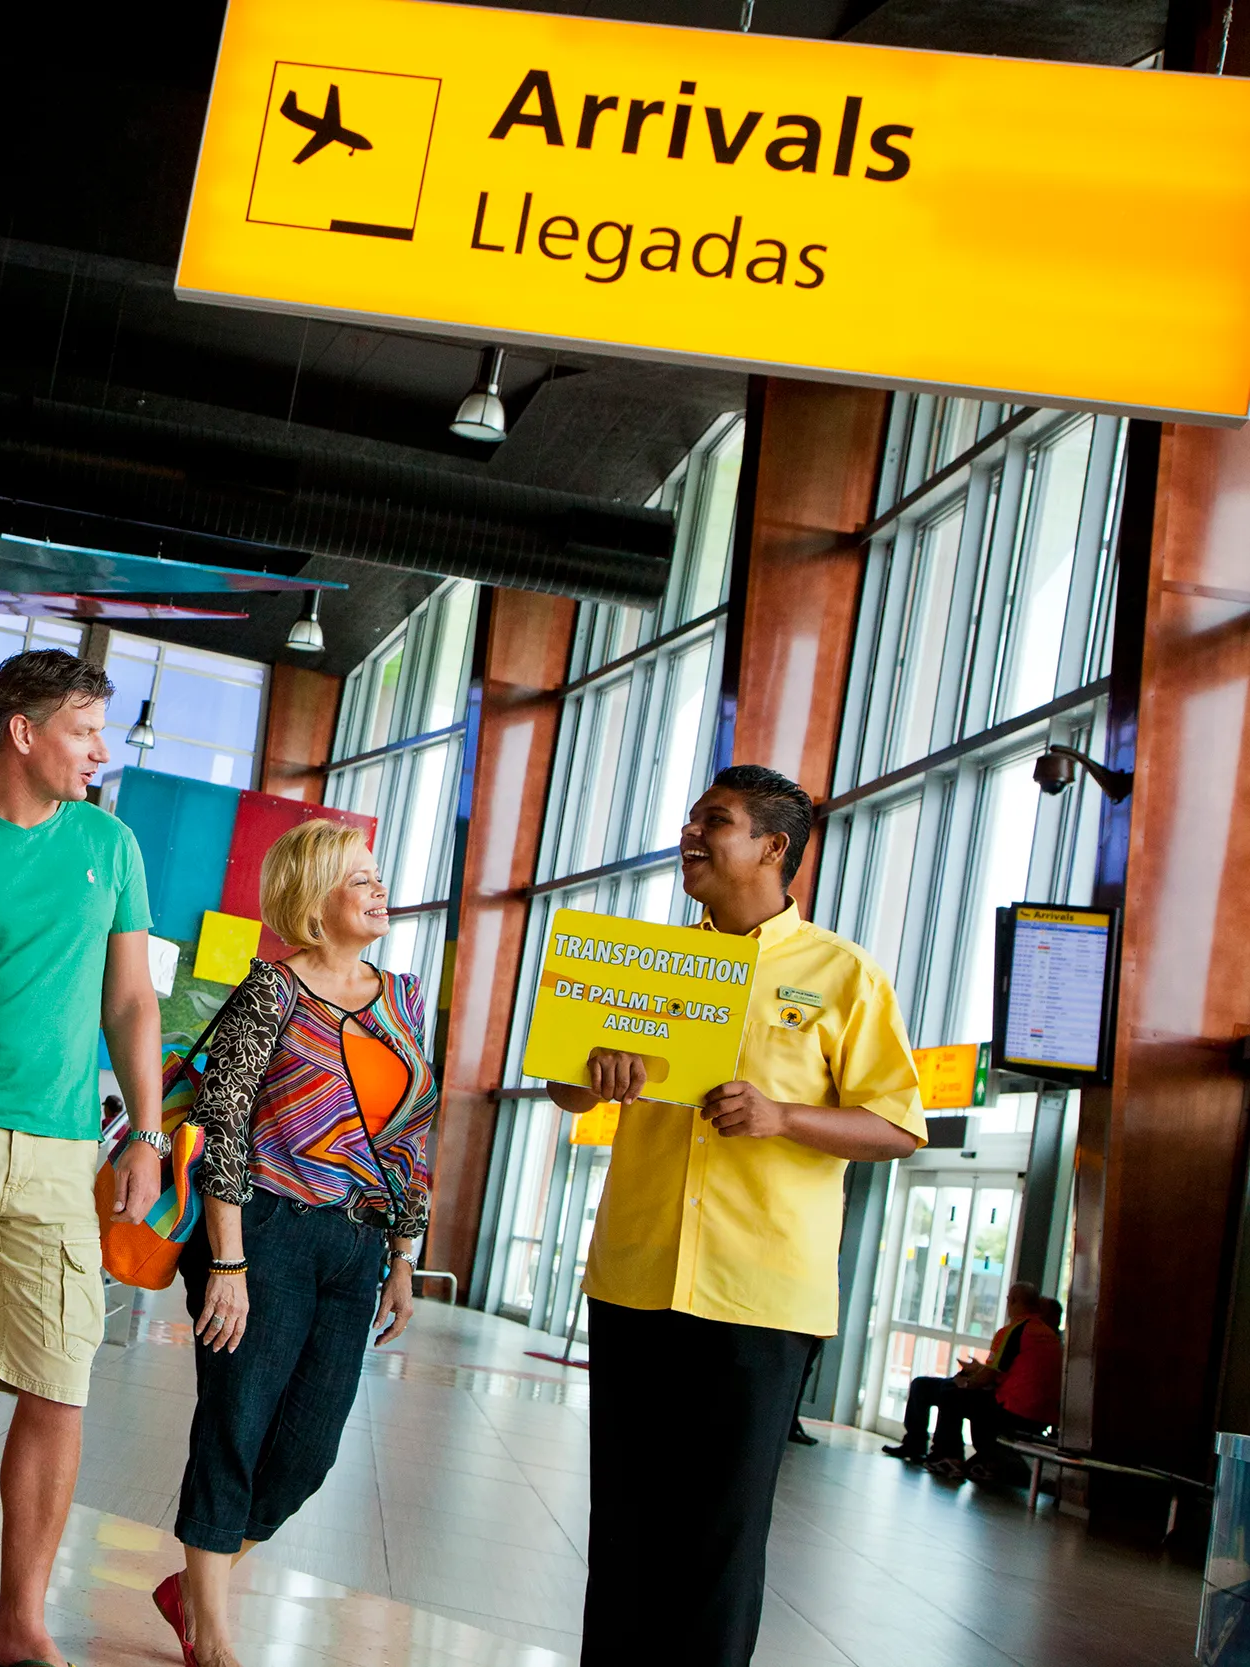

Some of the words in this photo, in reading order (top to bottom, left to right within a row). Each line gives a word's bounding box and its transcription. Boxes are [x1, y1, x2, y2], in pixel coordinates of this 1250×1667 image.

[489, 69, 915, 183] Arrivals
[470, 191, 828, 290] Llegadas
[1033, 911, 1074, 921] Arrivals
[554, 933, 750, 986] TRANSPORTATION
[554, 980, 585, 1000] DE
[588, 985, 649, 1011] PALM
[653, 996, 731, 1025] TOURS
[603, 1014, 670, 1039] ARUBA
